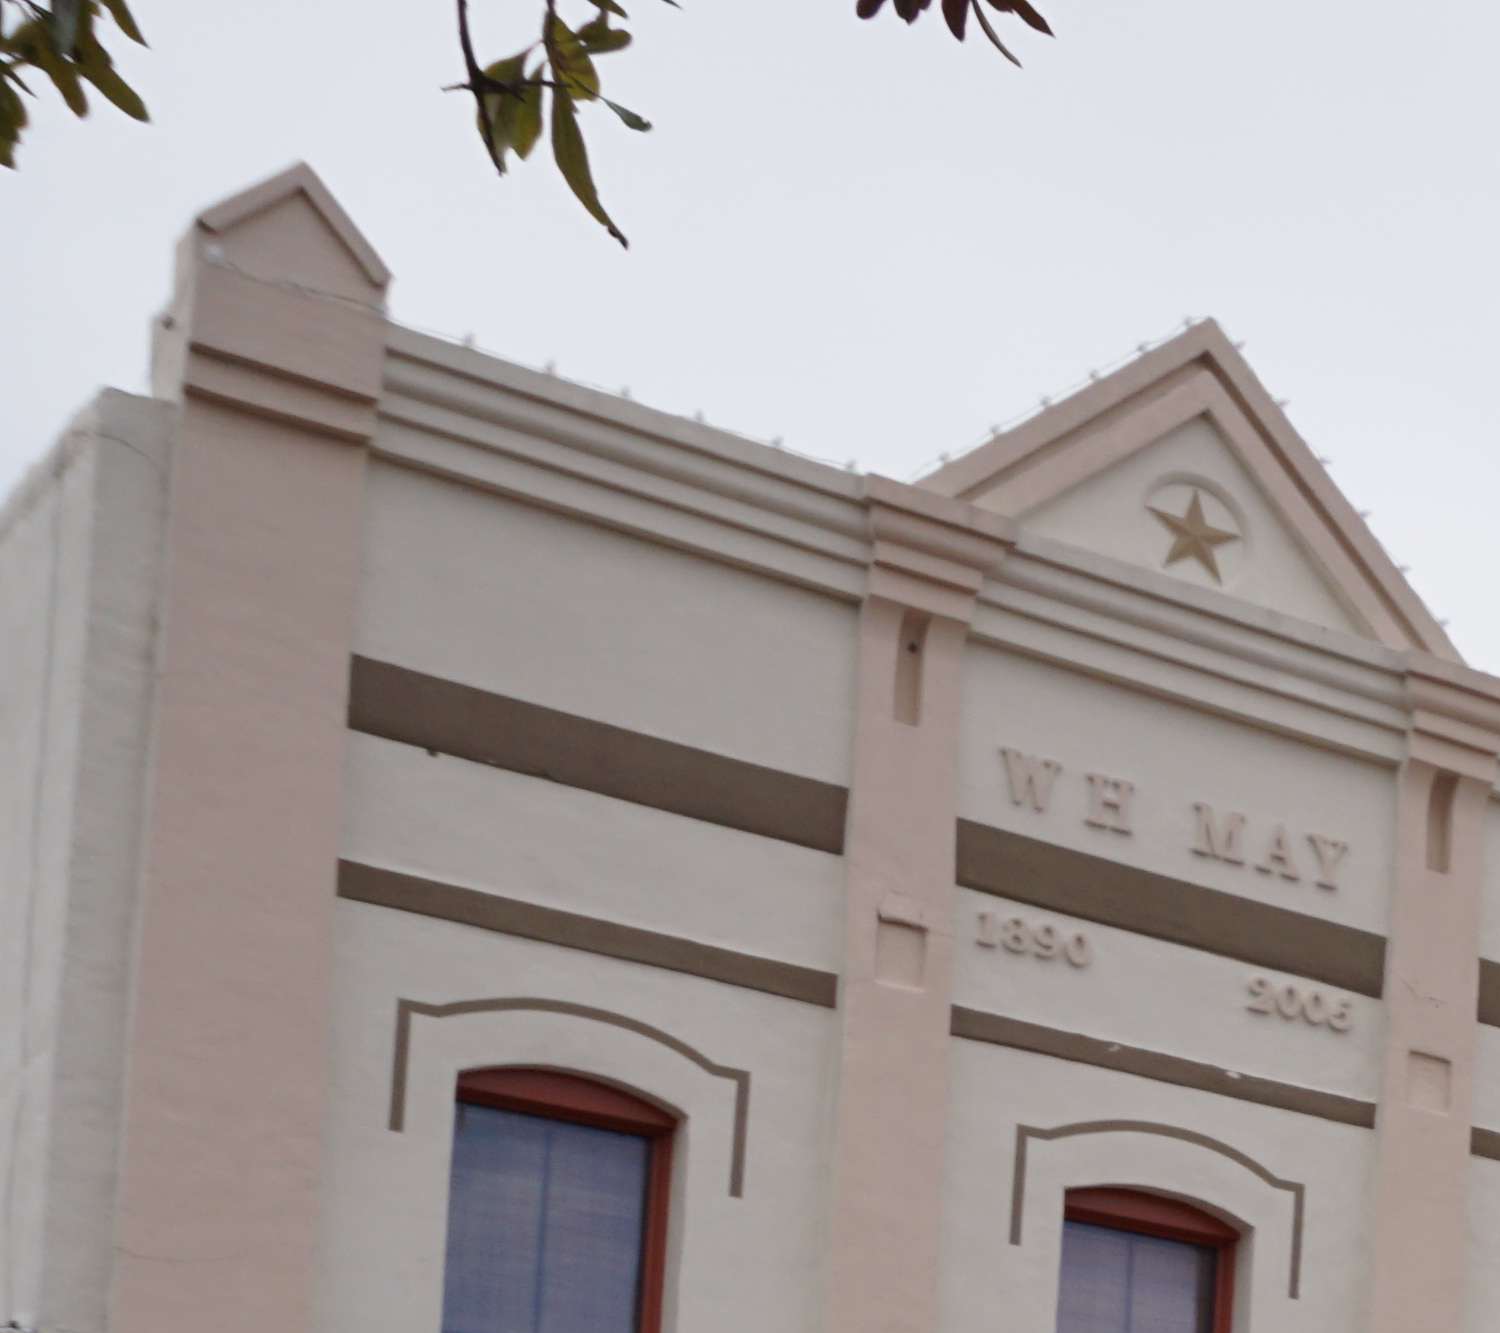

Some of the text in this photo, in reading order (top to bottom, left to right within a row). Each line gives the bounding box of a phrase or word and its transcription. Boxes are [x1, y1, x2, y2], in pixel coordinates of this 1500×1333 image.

[1188, 801, 1350, 891] MAY
[973, 910, 1093, 970] 1890
[1244, 977, 1354, 1034] 2005
